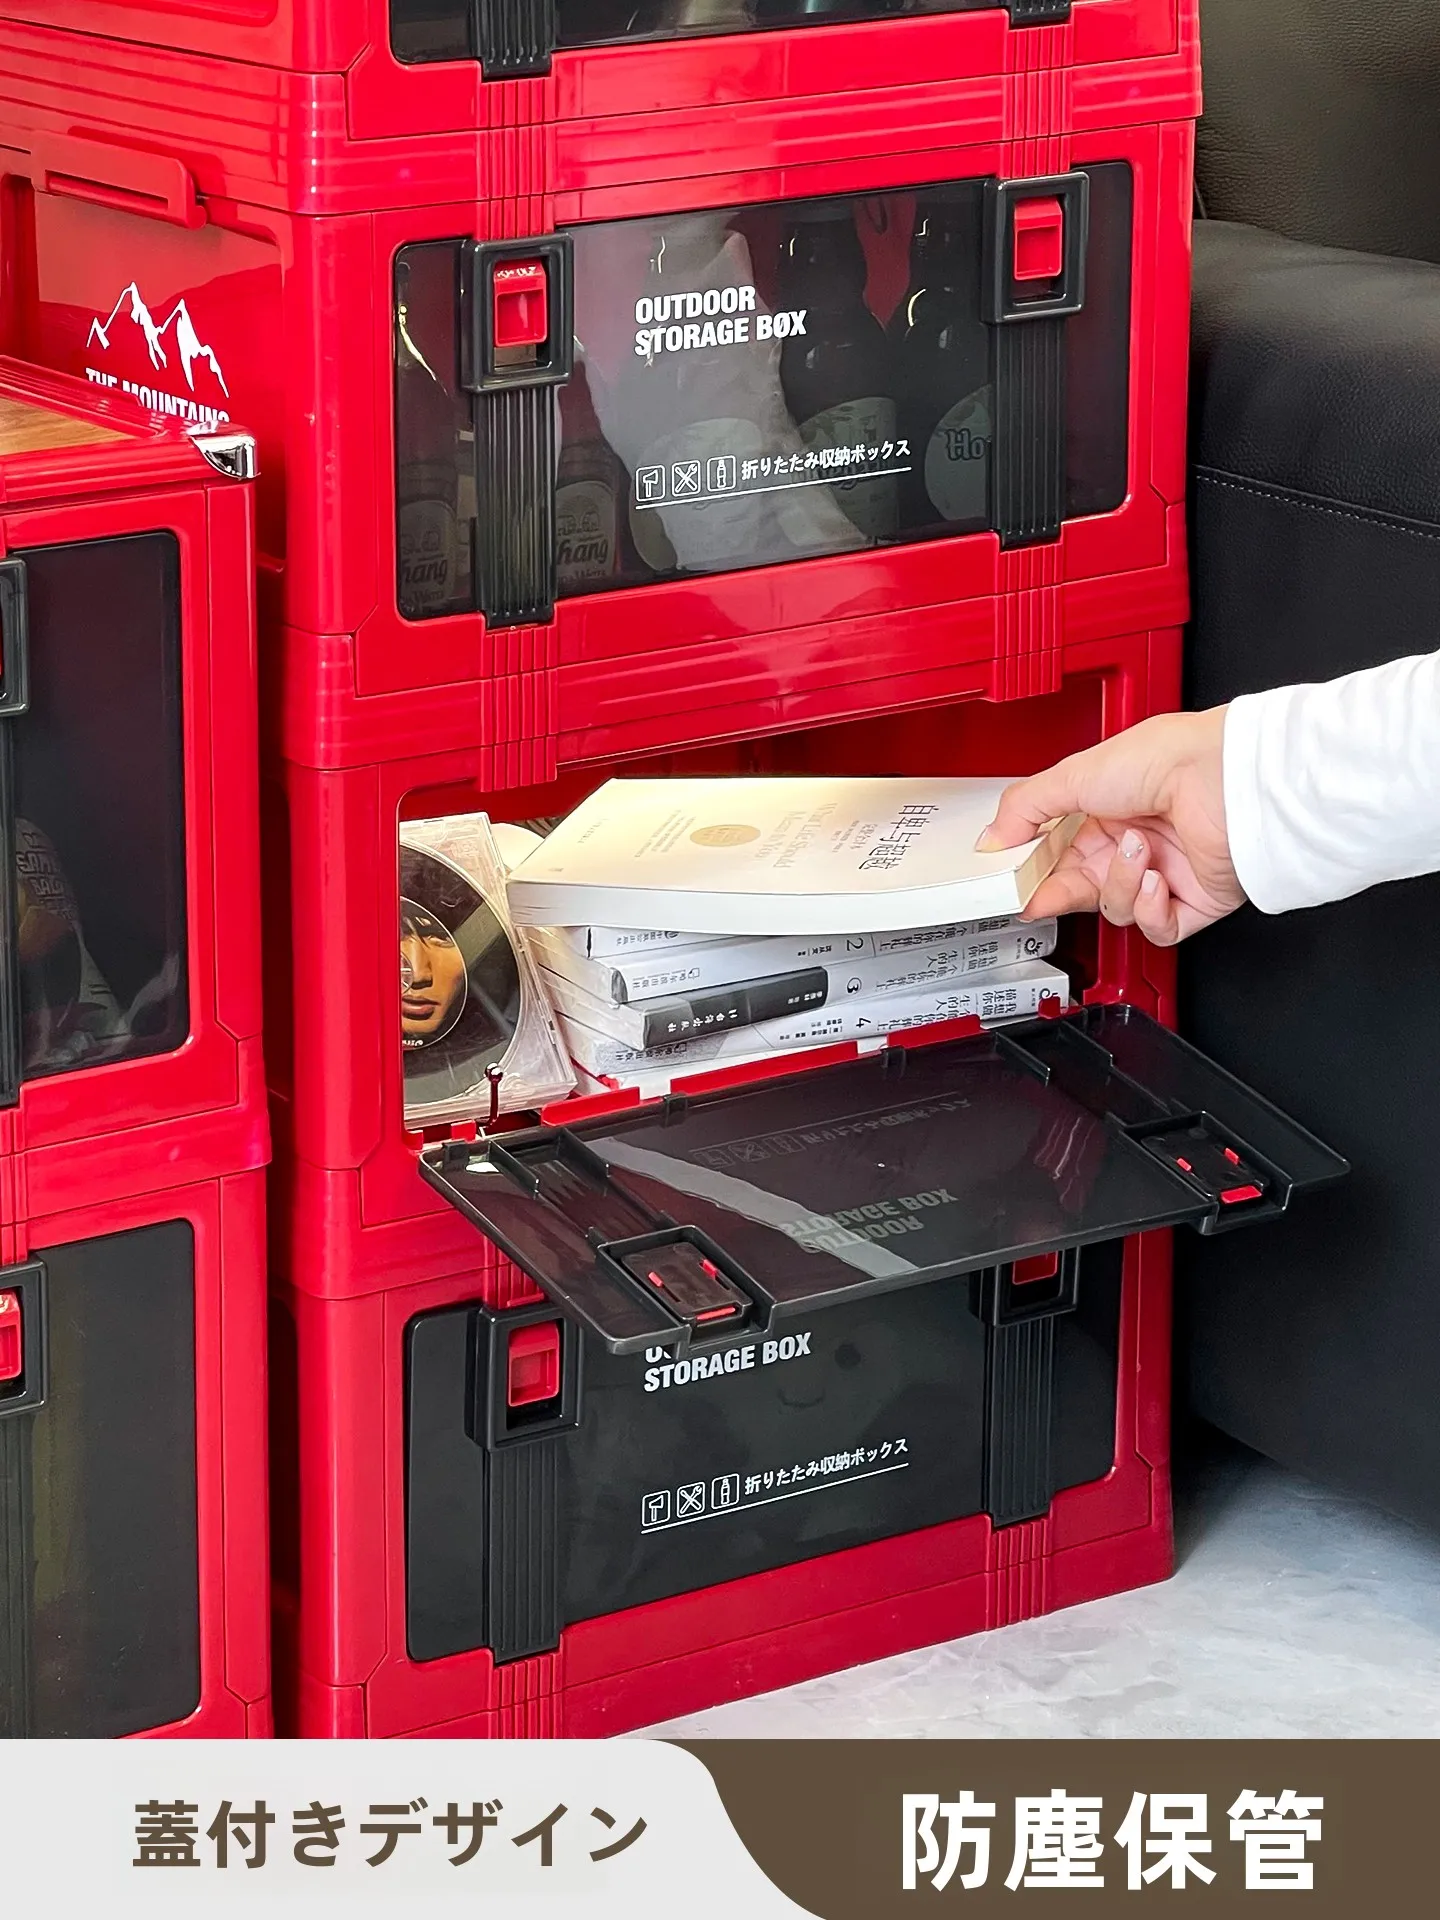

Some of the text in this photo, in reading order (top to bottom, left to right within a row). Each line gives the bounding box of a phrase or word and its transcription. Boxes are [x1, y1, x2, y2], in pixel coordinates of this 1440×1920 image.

[634, 285, 756, 324] OUTDOOR
[634, 309, 808, 357] STORAGE BOX
[741, 439, 911, 481] 折りたたみ収納ボックス
[557, 539, 609, 565] hang
[857, 804, 940, 870] 自卑与超越
[846, 937, 864, 951] 2
[855, 1017, 872, 1029] 4
[643, 1345, 755, 1392] STORAGE
[762, 1332, 813, 1365] BOX
[744, 1438, 909, 1496] 折りたたみ収納ボックス
